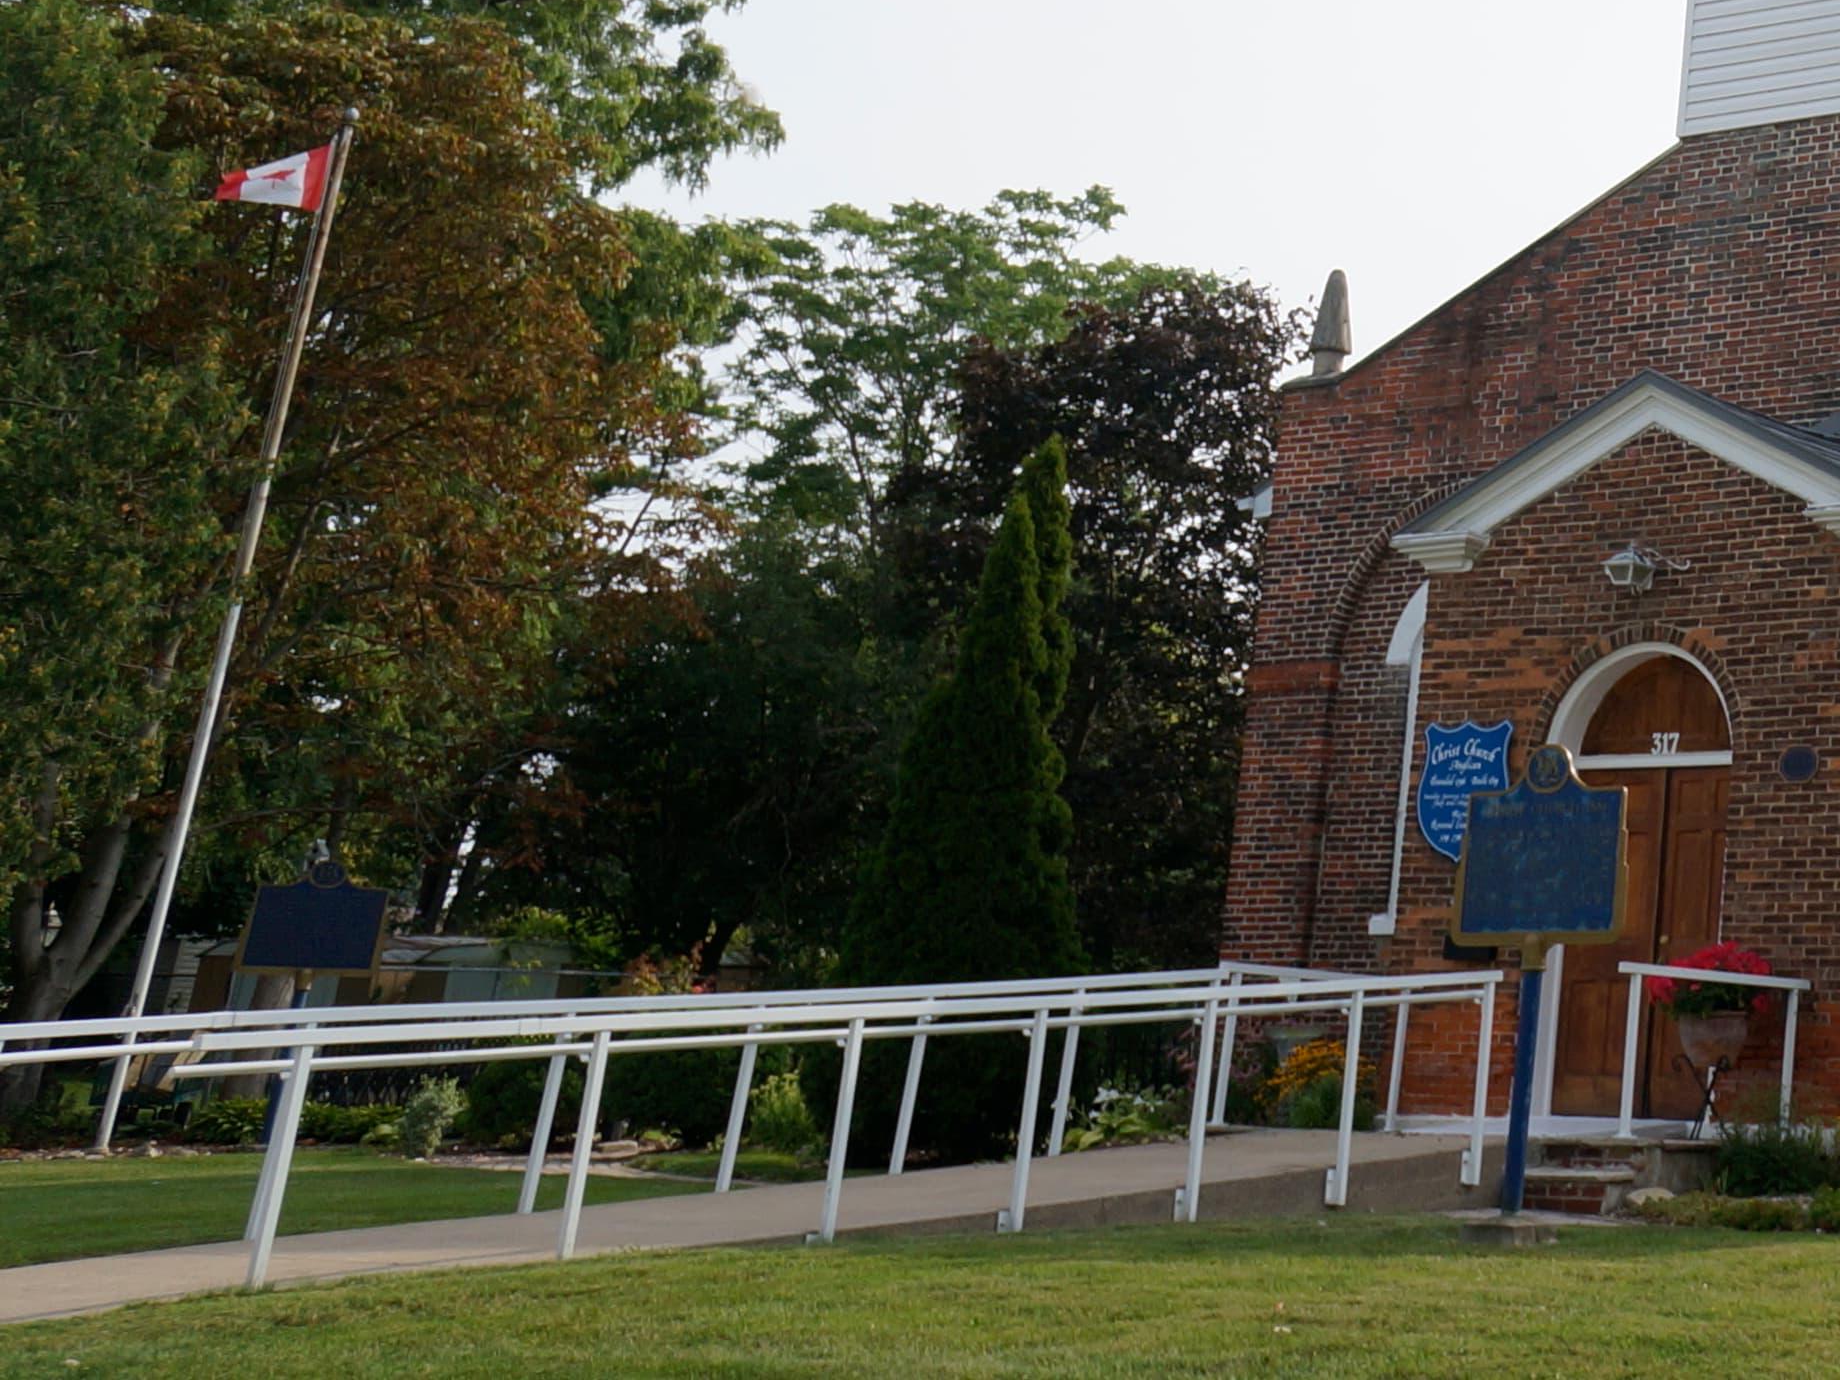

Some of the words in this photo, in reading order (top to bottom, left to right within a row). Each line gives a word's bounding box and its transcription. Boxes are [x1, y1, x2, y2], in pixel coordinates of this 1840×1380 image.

[1432, 742, 1460, 764] Christ
[1464, 738, 1501, 762] Church
[1652, 732, 1679, 755] 317
